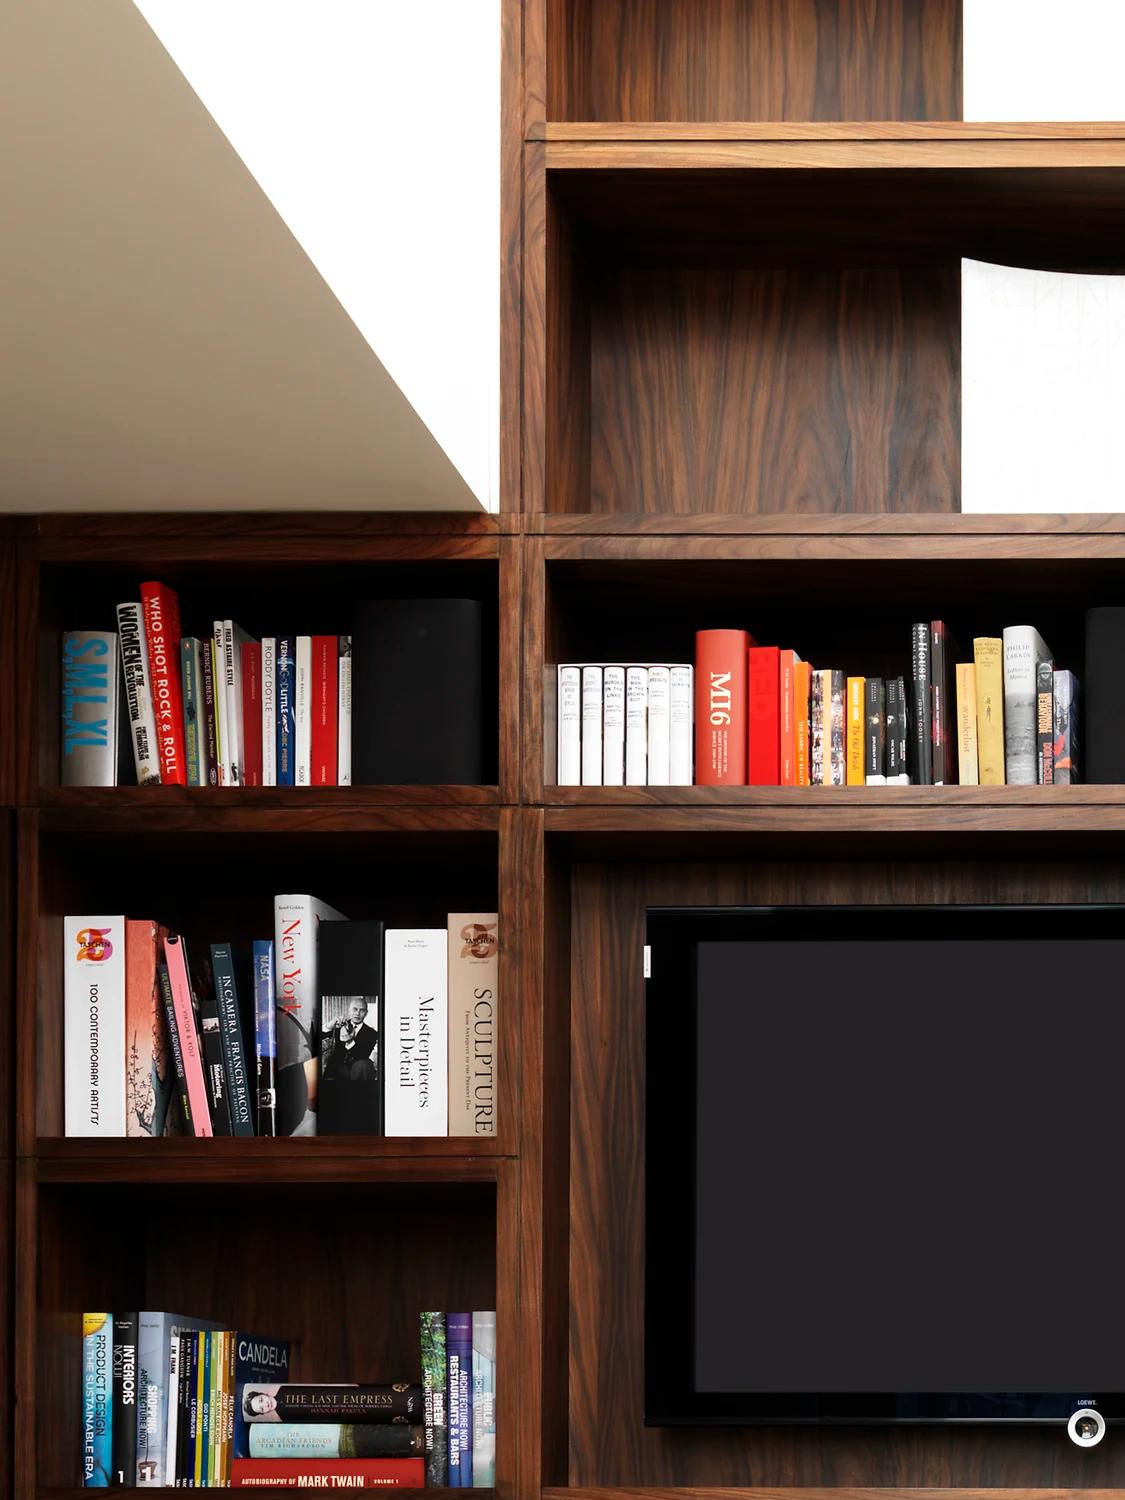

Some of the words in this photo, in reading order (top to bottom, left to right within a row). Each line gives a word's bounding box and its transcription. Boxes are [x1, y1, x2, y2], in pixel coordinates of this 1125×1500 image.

[149, 596, 161, 632] WHO
[117, 606, 142, 666] WOMEN
[152, 636, 167, 675] SHOT
[125, 665, 139, 721] REVOLUTION
[157, 679, 171, 719] ROCK
[710, 671, 732, 726] MI6
[162, 724, 169, 732] &
[961, 706, 972, 753] wanderlust
[164, 738, 177, 774] ROLL
[282, 919, 301, 963] New
[221, 975, 231, 987] IN
[260, 955, 269, 981] NASA
[89, 983, 99, 1003] 100
[223, 989, 237, 1034] CAMERA
[282, 968, 301, 1017] York
[399, 1016, 415, 1031] in
[89, 1006, 98, 1086] CONTEMPORARY
[229, 1041, 244, 1085] FRANCIS
[399, 1037, 415, 1088] Detail
[413, 996, 434, 1108] Masterpieces
[474, 988, 493, 1134] SCULPTURE
[90, 1089, 99, 1126] ARTISTS
[234, 1087, 249, 1123] BACON
[86, 1335, 94, 1346] IN
[86, 1350, 94, 1371] THE
[239, 1341, 288, 1368] CANDELA
[96, 1335, 105, 1391] PRODUCT
[122, 1345, 135, 1404] INTERIORS
[285, 1394, 307, 1404] THE
[311, 1395, 339, 1404] LAST
[343, 1395, 393, 1404] EMPRESS
[450, 1356, 459, 1425] RESTAURANTS
[459, 1370, 468, 1428] ARCHITECTURE
[85, 1375, 94, 1454] SUSTAINABLE
[96, 1394, 105, 1436] DESIGN
[450, 1439, 459, 1465] BARS
[460, 1429, 468, 1450] NOW!
[85, 1456, 93, 1480] ERA
[298, 1476, 328, 1487] MARK
[330, 1476, 364, 1487] TWAIN
